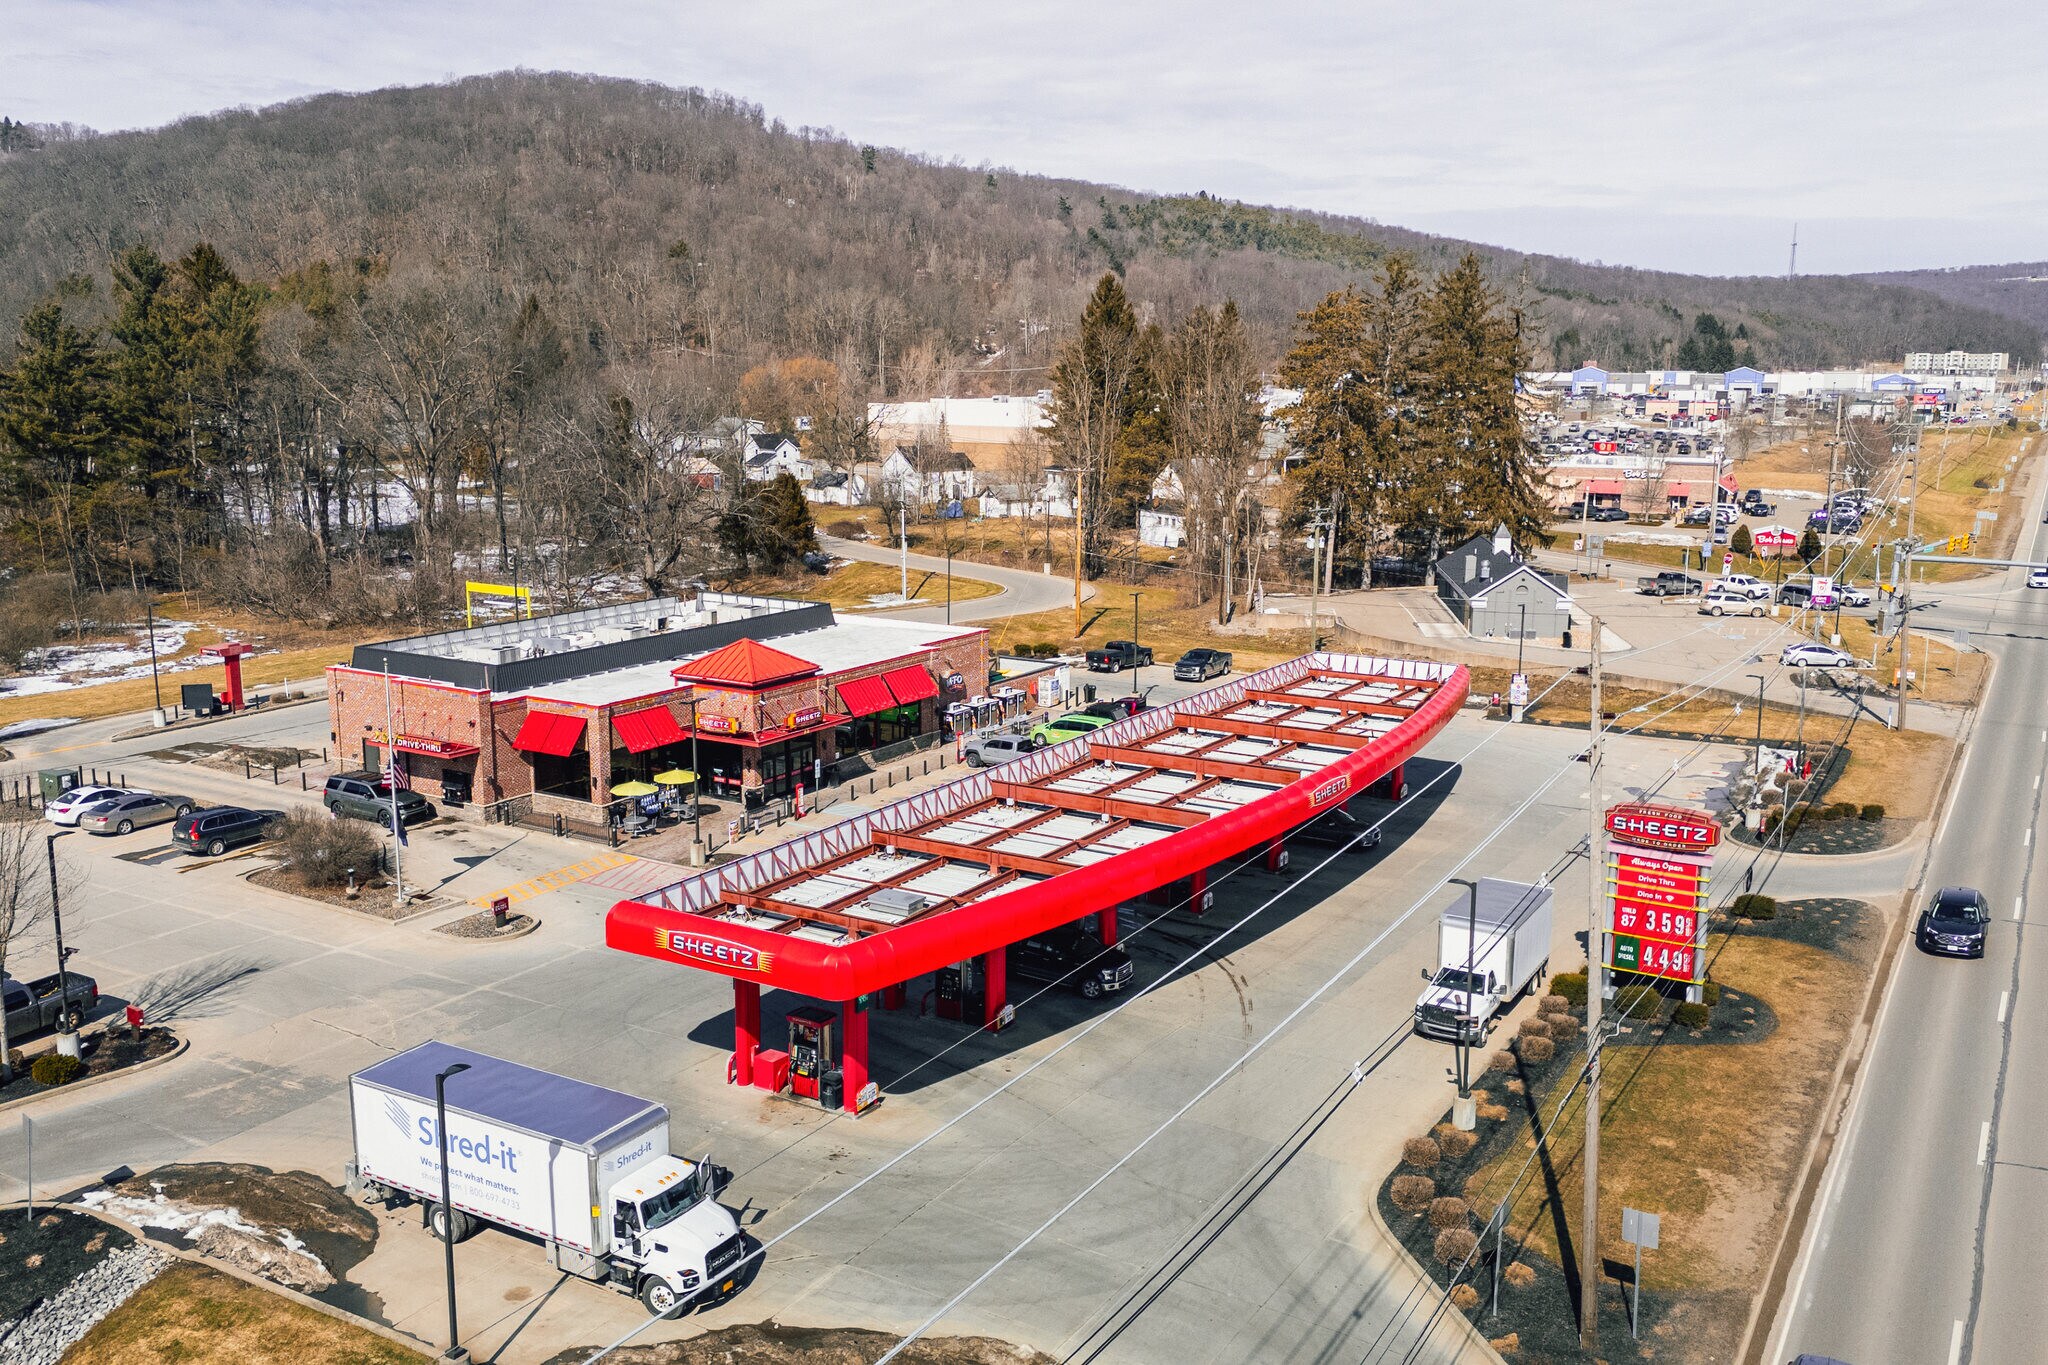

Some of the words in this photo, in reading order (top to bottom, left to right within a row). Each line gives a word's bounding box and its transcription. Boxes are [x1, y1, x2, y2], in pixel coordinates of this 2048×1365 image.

[1623, 469, 1640, 479] Bob
[1757, 535, 1773, 543] Bob
[698, 718, 729, 729] SHEETZ
[795, 711, 821, 723] SHEETZ
[397, 738, 441, 752] DRIVE-THRU
[1315, 778, 1346, 803] SHEETZ
[1664, 812, 1683, 820] FOOD
[1613, 816, 1708, 842] SHEETZ
[1631, 857, 1660, 870] Always
[1662, 861, 1684, 872] Open
[1638, 875, 1657, 884] Drive
[1658, 878, 1676, 887] Thru
[1637, 890, 1654, 899] Dine
[1620, 914, 1637, 927] 87
[1645, 909, 1685, 935] 3.59
[673, 935, 754, 966] SHEETZ
[1619, 944, 1634, 953] AUTO
[1643, 946, 1683, 971] 4.49
[418, 1116, 517, 1173] Shred-it
[617, 1141, 652, 1169] Shred-it
[420, 1156, 433, 1167] We
[434, 1163, 463, 1178] ptect
[464, 1171, 484, 1184] what
[485, 1178, 519, 1196] matters.
